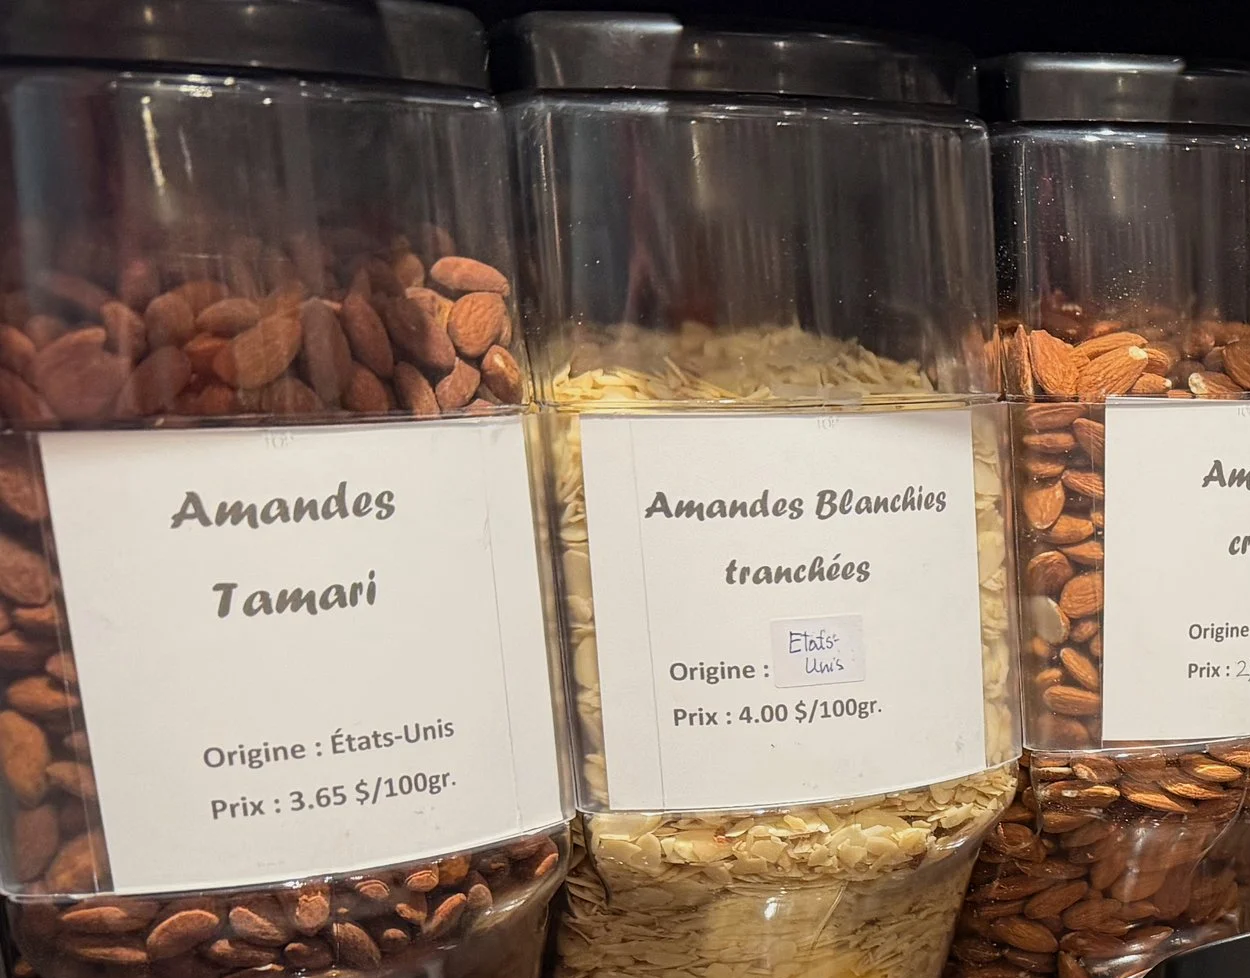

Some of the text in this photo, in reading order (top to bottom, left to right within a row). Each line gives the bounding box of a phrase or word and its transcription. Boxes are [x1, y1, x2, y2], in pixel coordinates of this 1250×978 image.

[170, 481, 396, 529] Amandes
[644, 485, 948, 520] Amandes Blanchies
[725, 553, 872, 585] tranchées
[212, 570, 377, 618] Tamari
[1188, 623, 1250, 643] Origine
[669, 662, 756, 686] Origine
[805, 657, 844, 674] Unis
[1188, 662, 1220, 679] Prix
[673, 707, 718, 727] Prix
[739, 704, 788, 725] 4.00
[794, 698, 883, 724] $/100gr.
[203, 738, 306, 770] Origine
[330, 718, 455, 756] États-Unis
[211, 794, 265, 820] Prix
[290, 785, 347, 813] 3.65
[354, 770, 457, 807] $/100gr.
